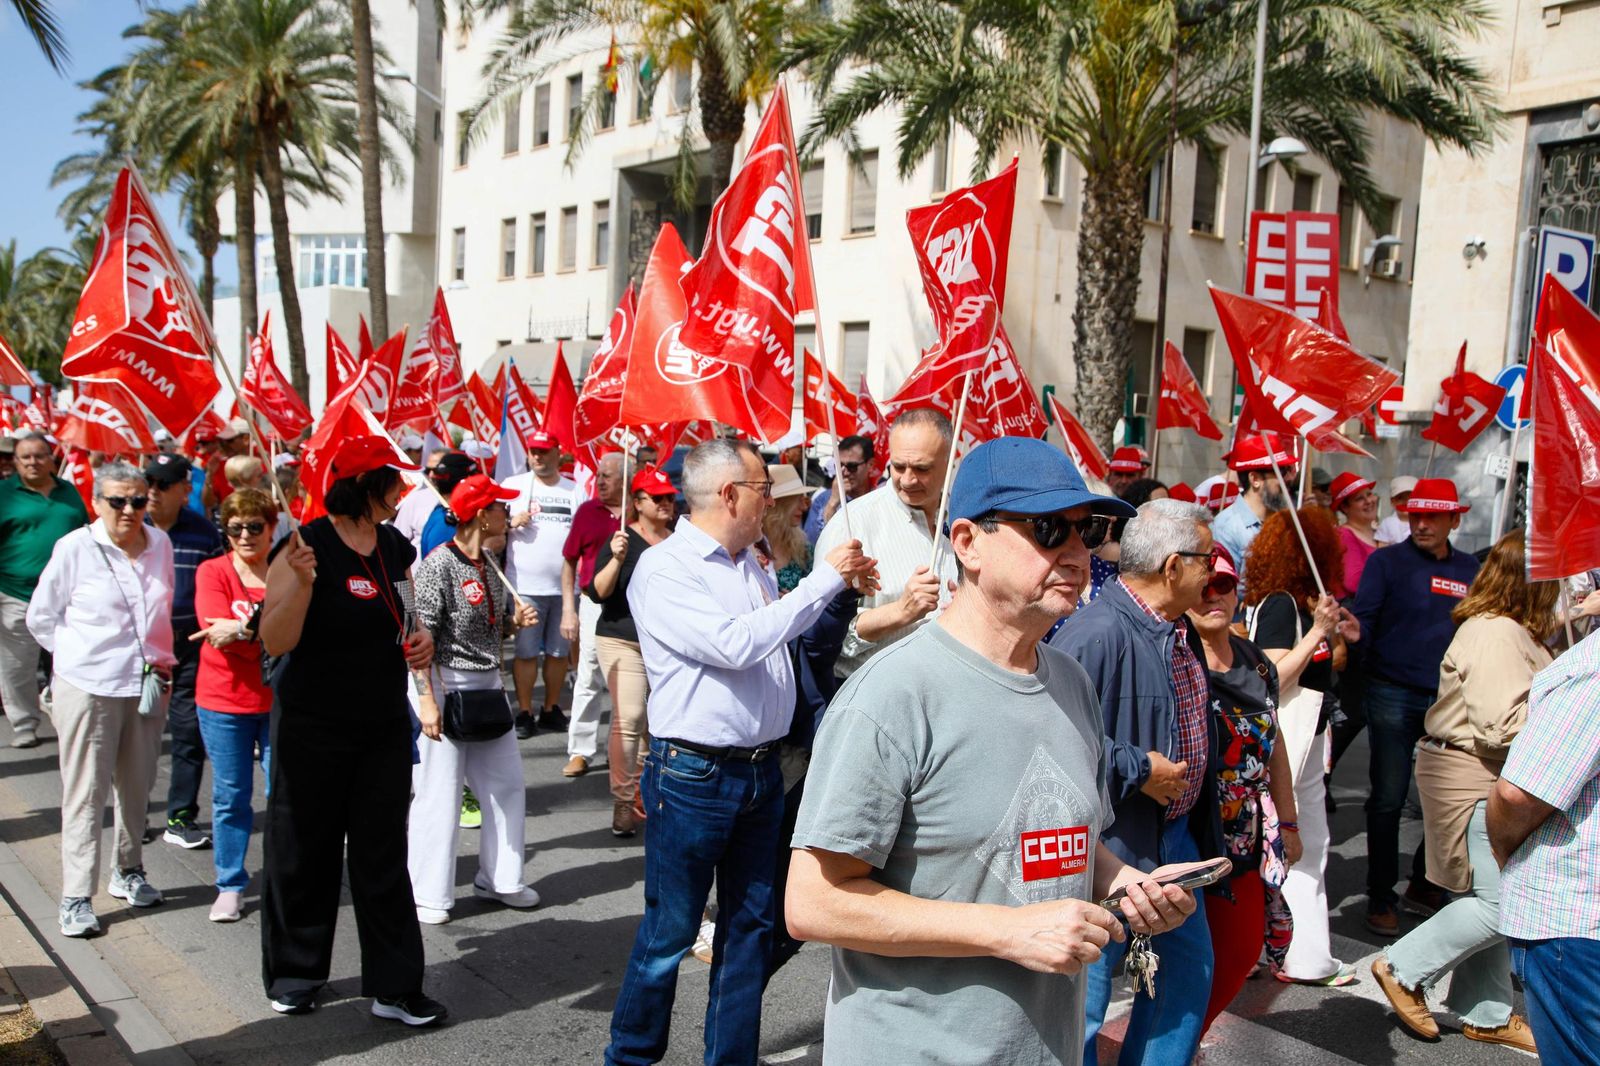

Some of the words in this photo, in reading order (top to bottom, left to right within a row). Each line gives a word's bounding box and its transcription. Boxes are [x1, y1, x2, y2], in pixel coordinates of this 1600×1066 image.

[1546, 232, 1590, 292] P
[1431, 577, 1468, 594] CCOO
[1023, 832, 1088, 863] CCOO
